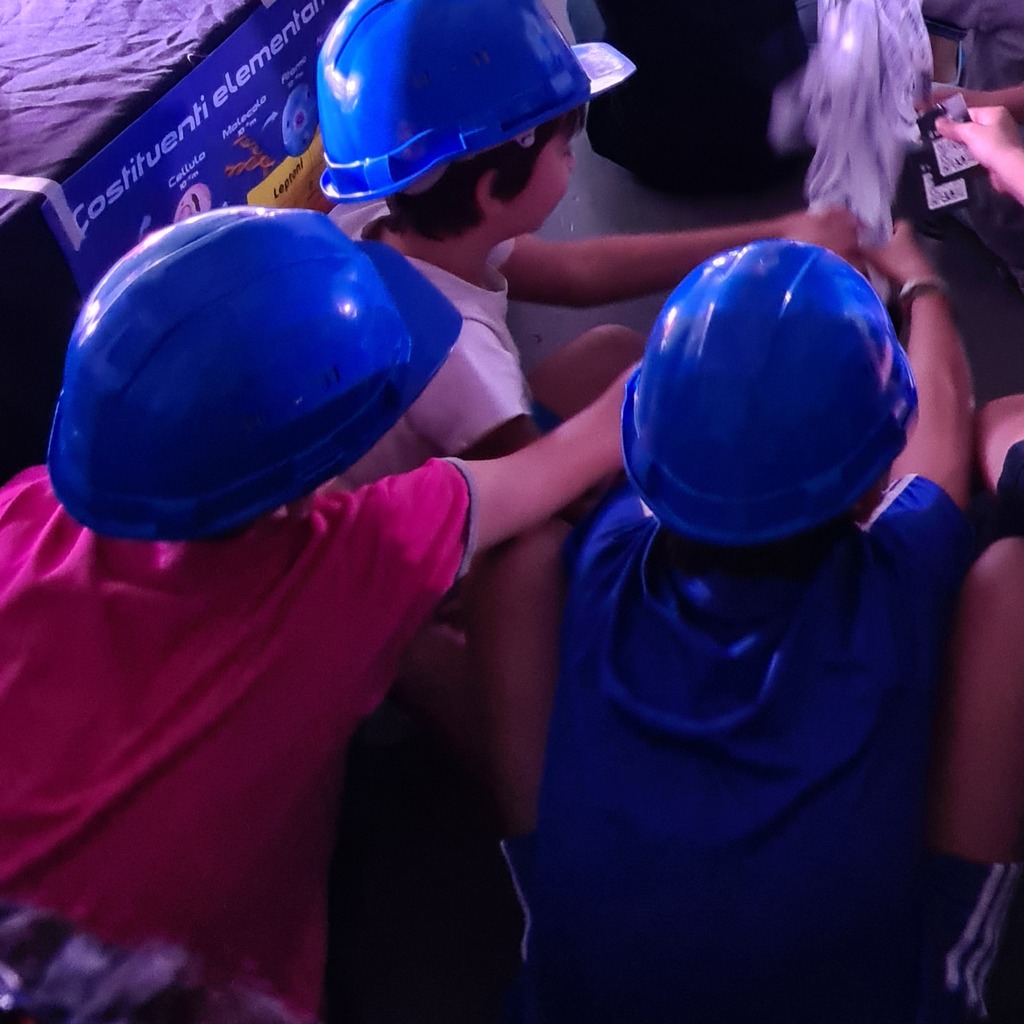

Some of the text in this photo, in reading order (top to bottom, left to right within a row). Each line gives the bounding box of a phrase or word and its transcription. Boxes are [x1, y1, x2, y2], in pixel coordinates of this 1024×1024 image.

[222, 95, 267, 140] Molecola
[73, 94, 210, 232] Costituenti
[168, 151, 206, 188] Cellula
